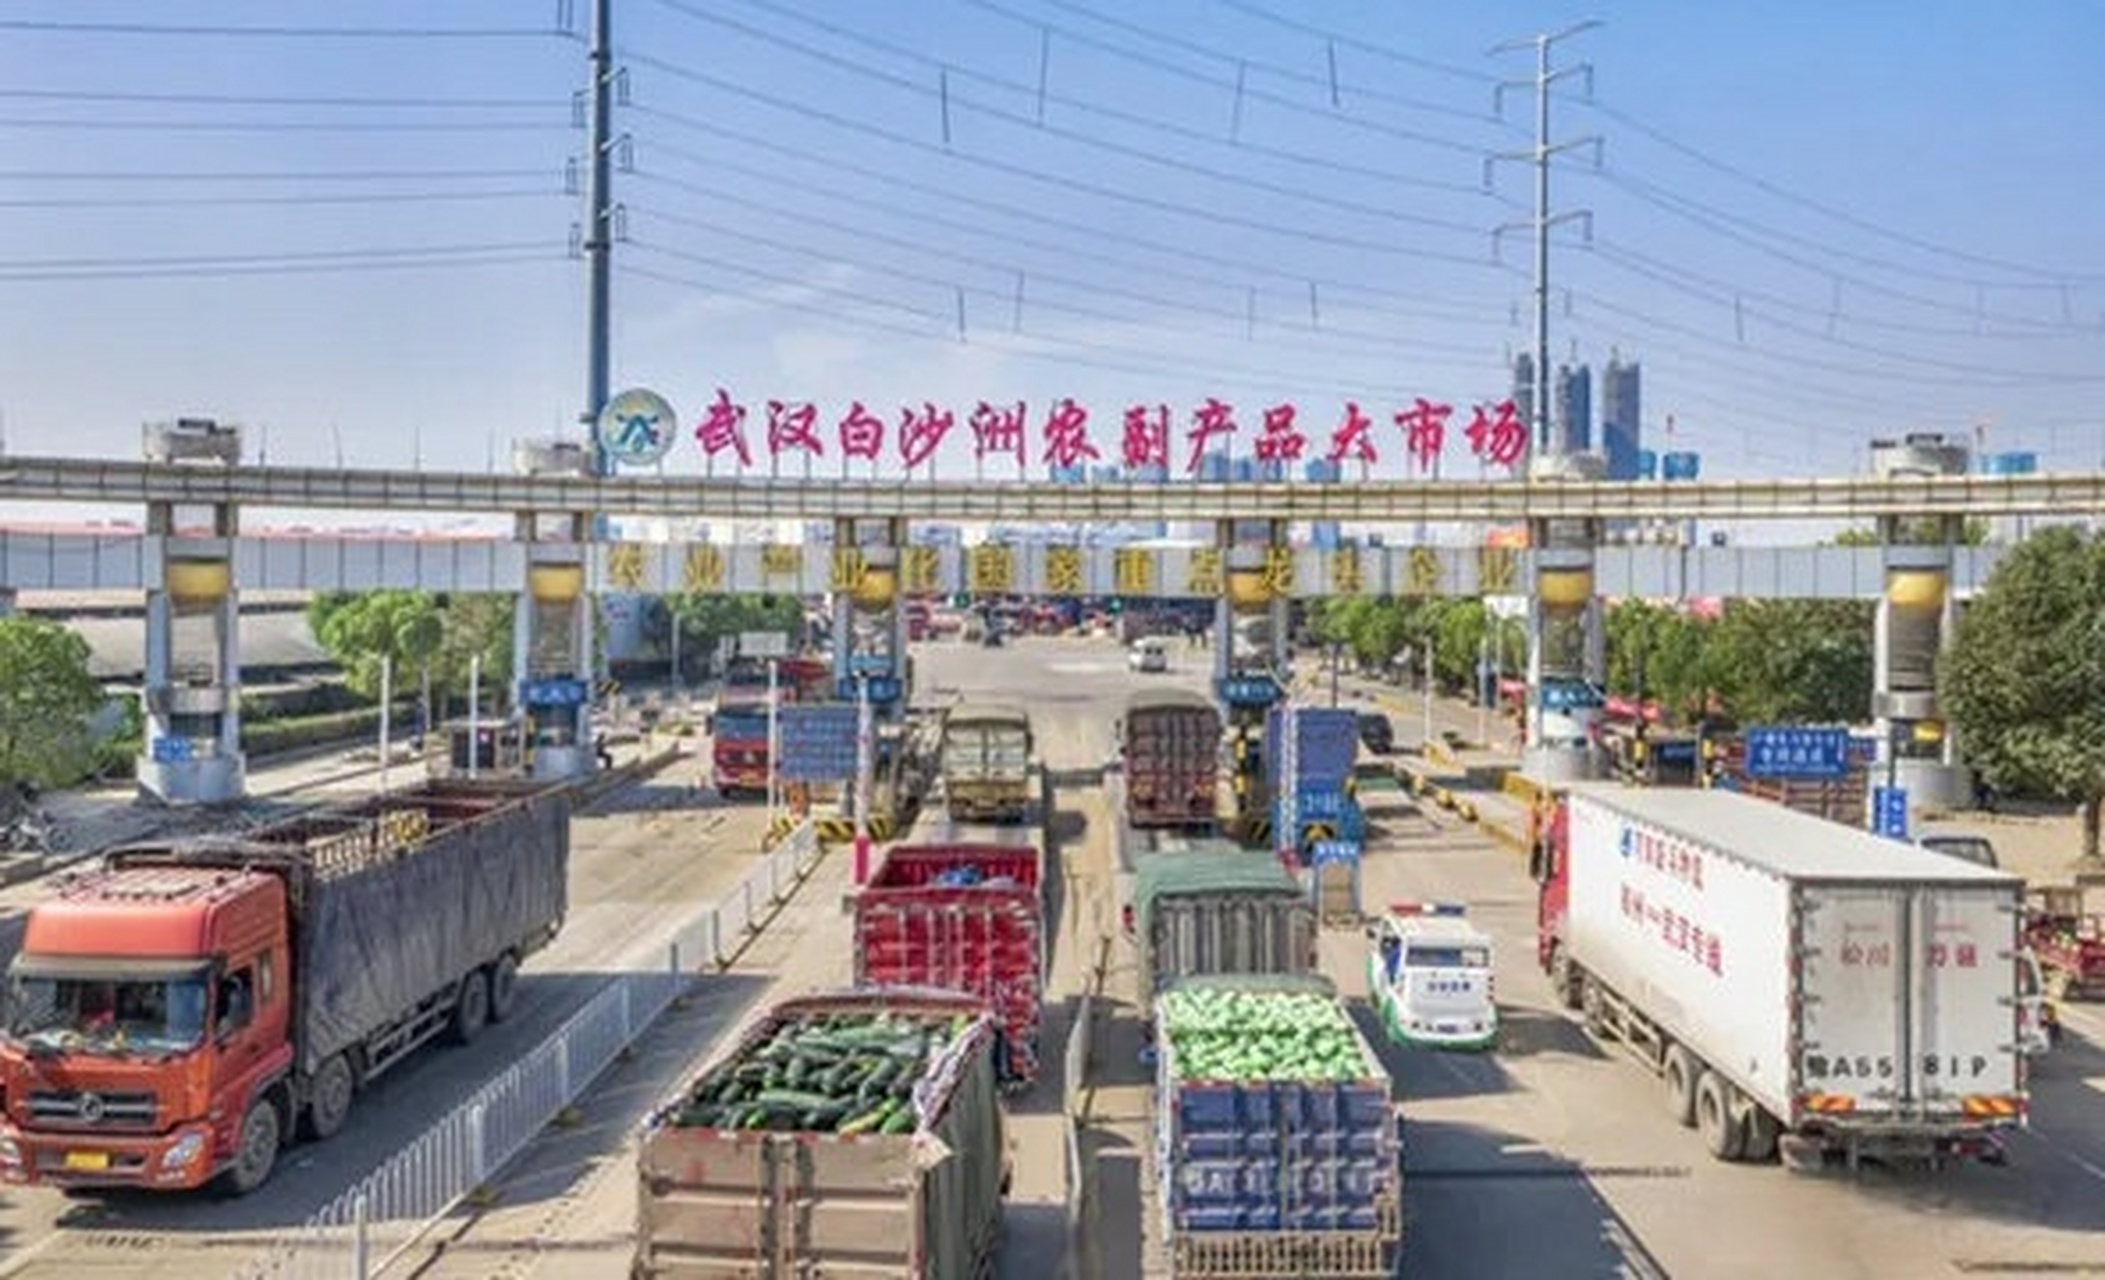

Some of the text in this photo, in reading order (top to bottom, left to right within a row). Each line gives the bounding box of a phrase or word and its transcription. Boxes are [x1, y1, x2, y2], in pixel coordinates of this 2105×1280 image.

[694, 388, 1530, 472] 武汉白沙洲农副产品大市场
